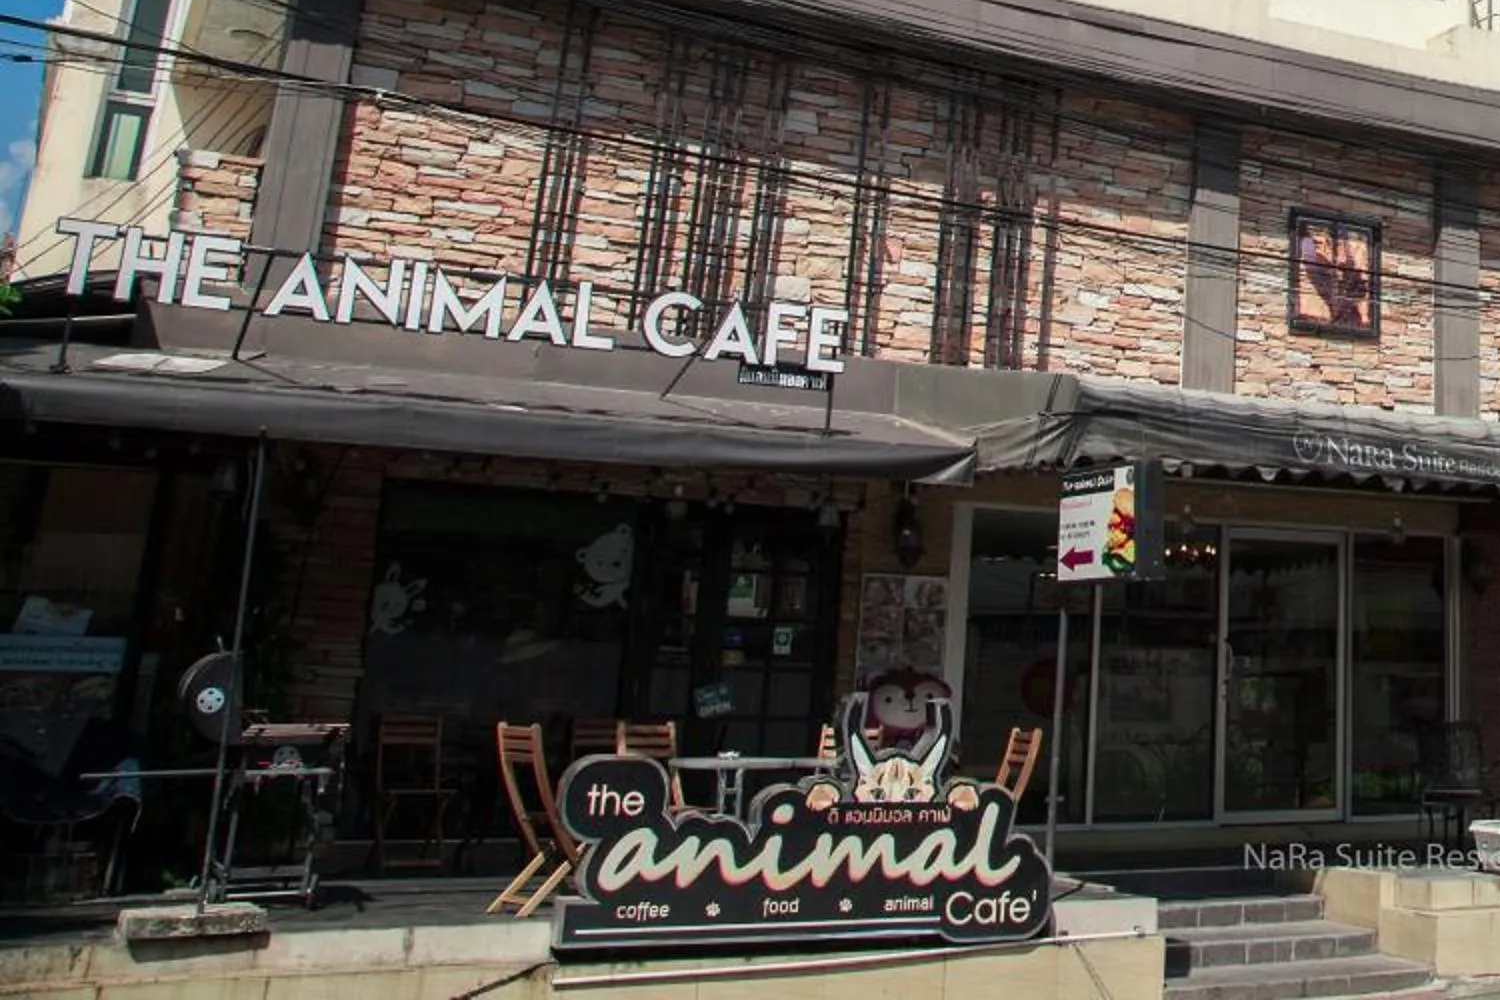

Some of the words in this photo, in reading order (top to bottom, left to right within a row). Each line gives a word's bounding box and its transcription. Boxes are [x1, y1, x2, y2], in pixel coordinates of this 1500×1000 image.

[57, 218, 242, 311] THE
[263, 249, 616, 351] ANIMAL
[642, 292, 850, 374] CAFE
[1401, 443, 1457, 474] Suite
[587, 783, 646, 817] the
[597, 801, 1022, 893] animal
[616, 901, 671, 922] coffee
[762, 897, 800, 918] food
[883, 895, 934, 912] animal
